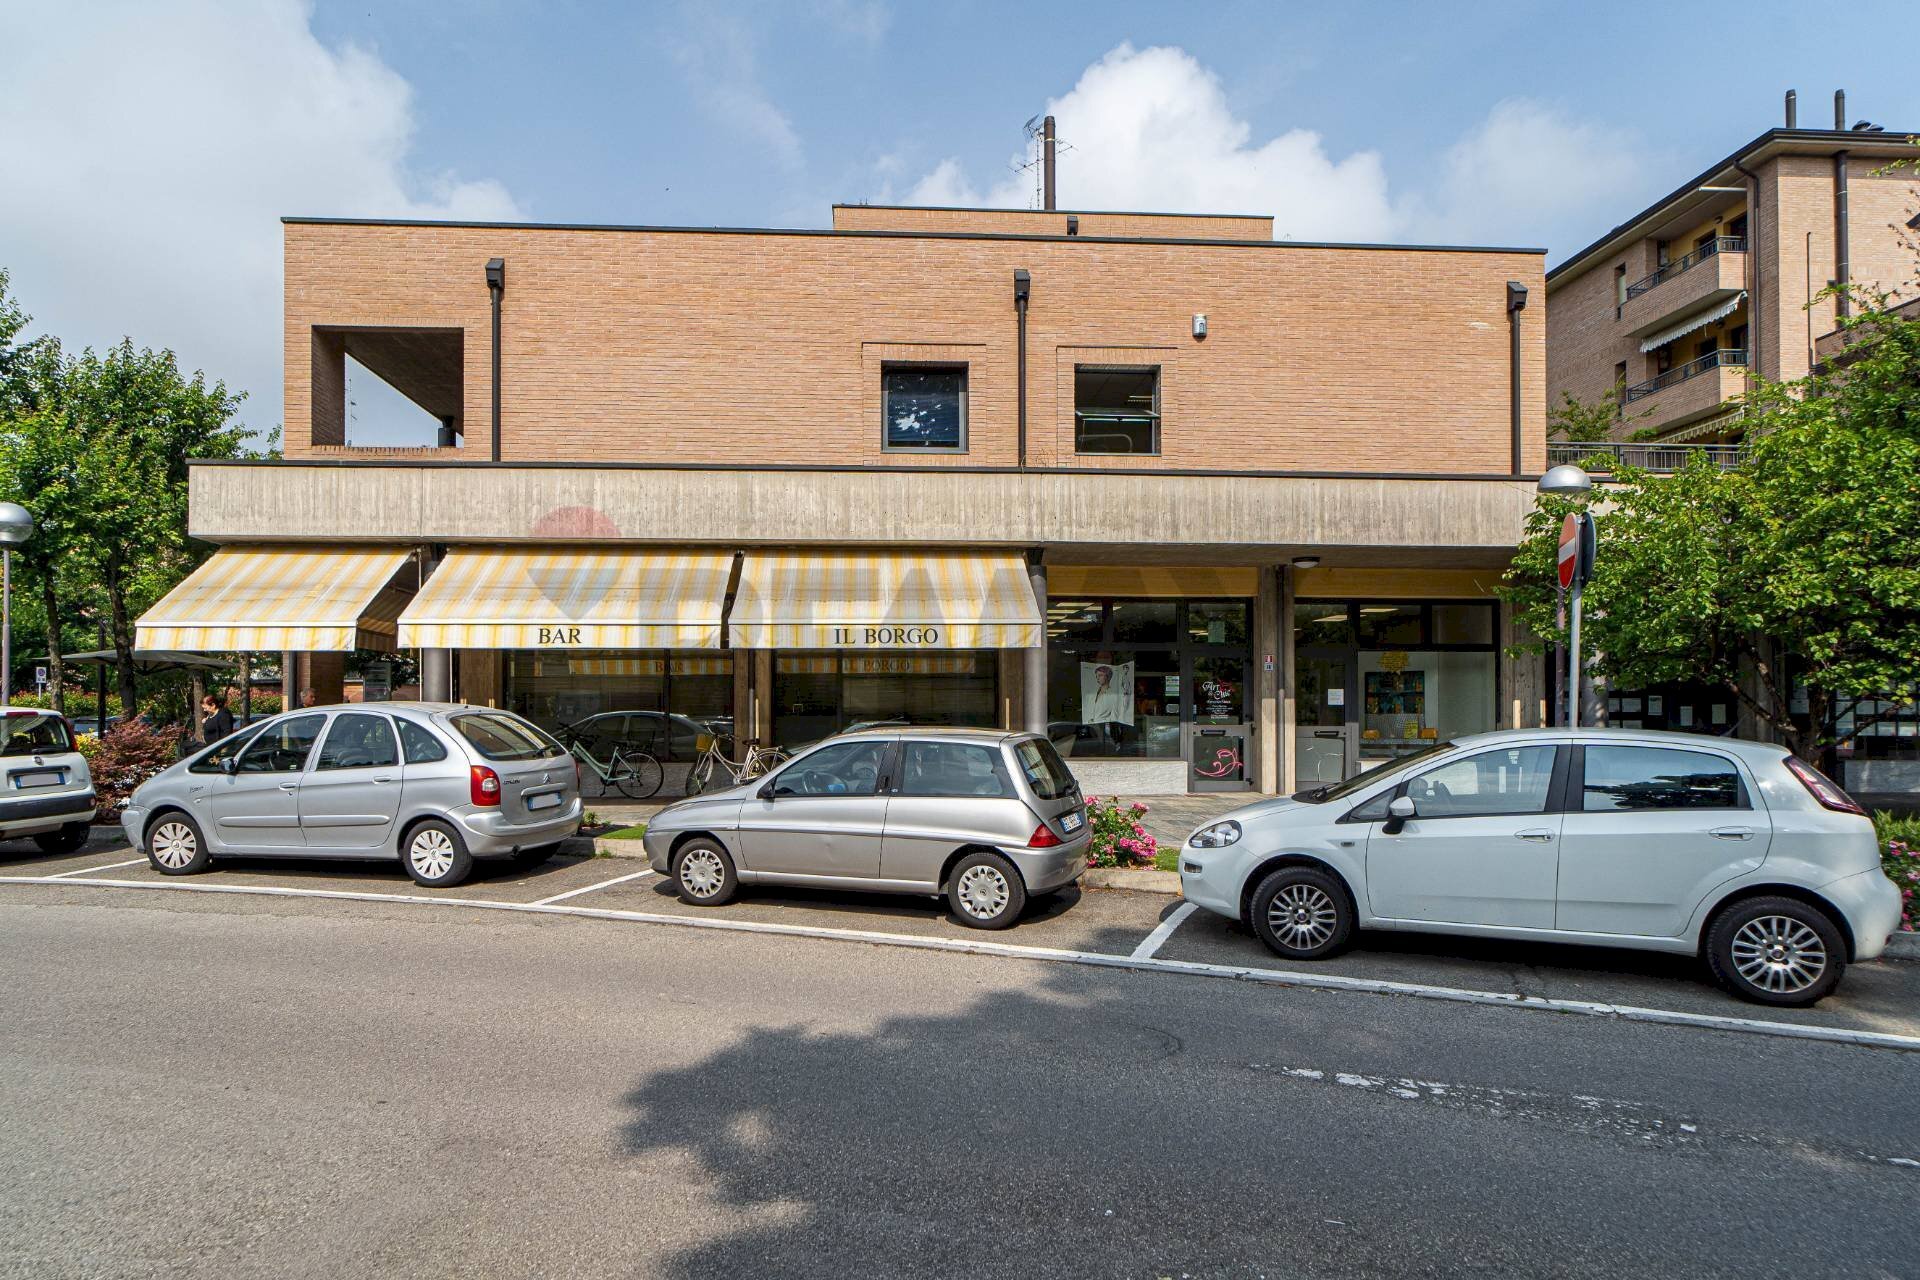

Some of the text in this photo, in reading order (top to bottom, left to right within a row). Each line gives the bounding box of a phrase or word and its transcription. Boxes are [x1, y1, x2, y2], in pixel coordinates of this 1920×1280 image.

[538, 628, 582, 644] BAR
[834, 628, 939, 644] IL BORGO
